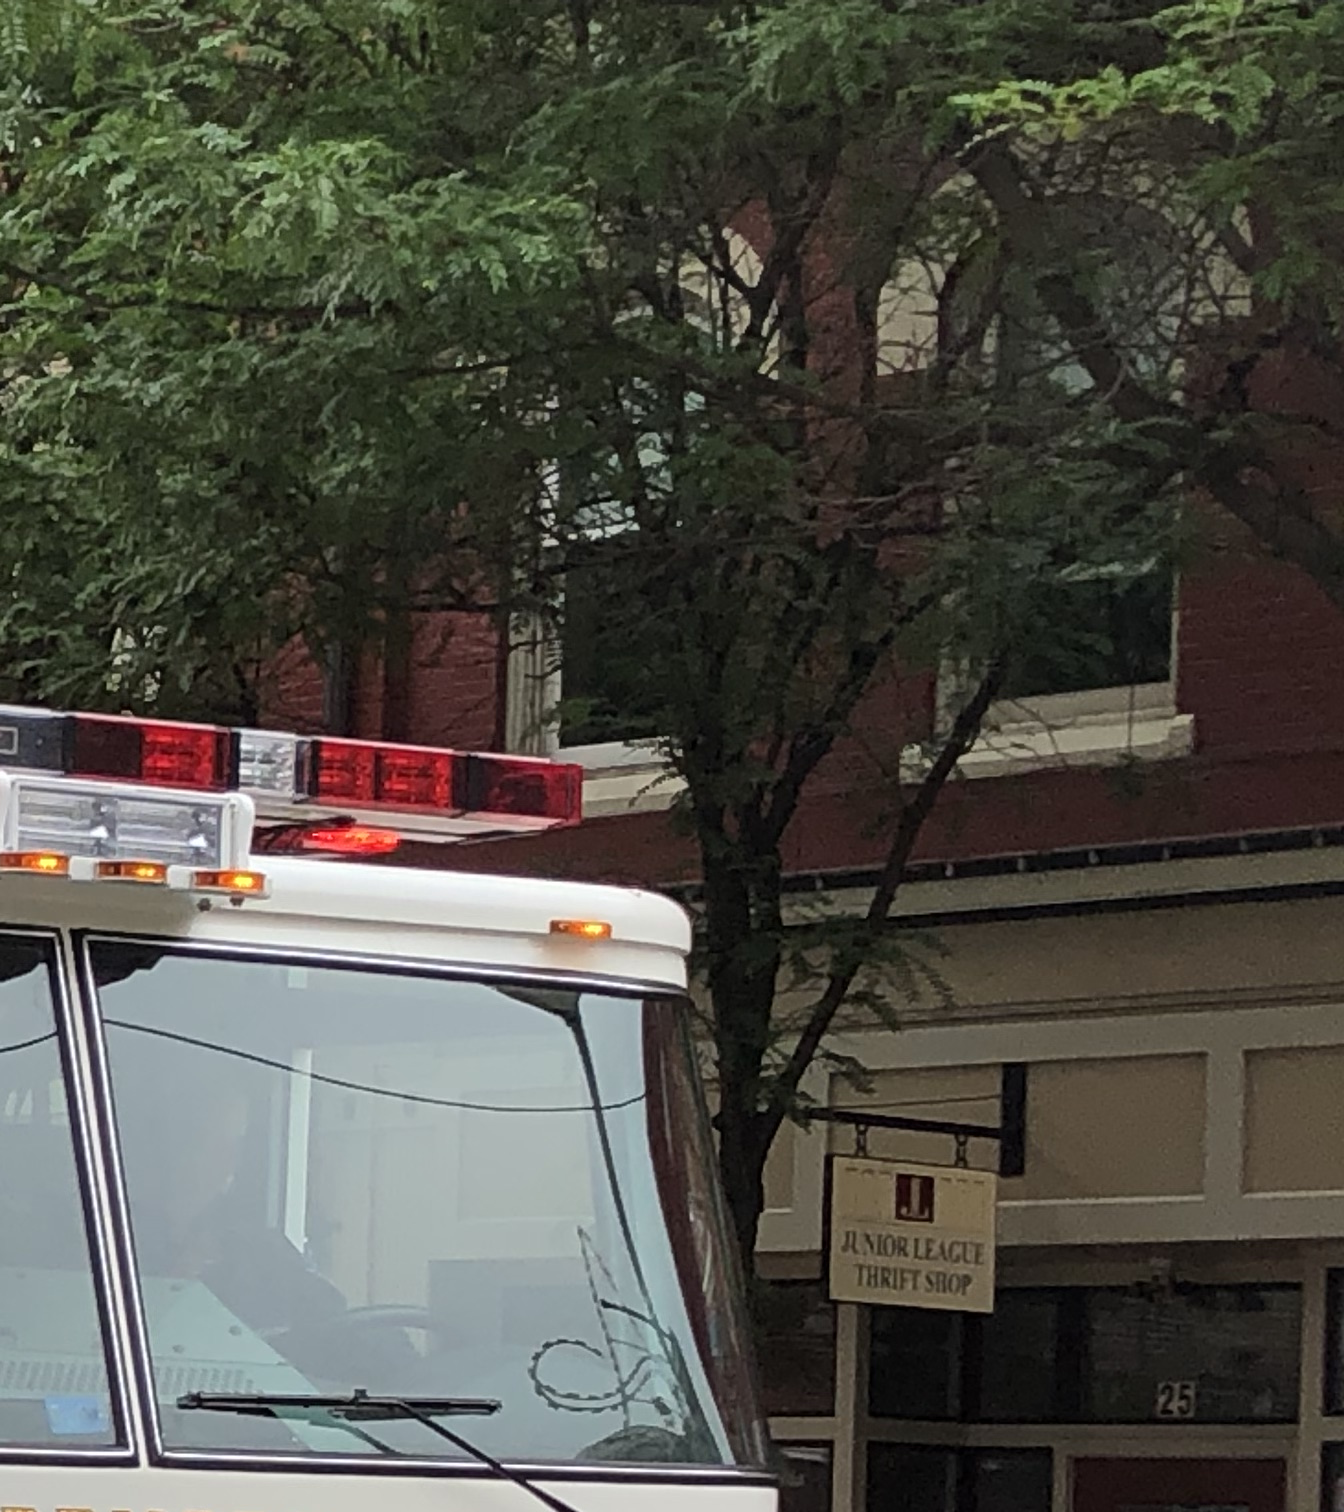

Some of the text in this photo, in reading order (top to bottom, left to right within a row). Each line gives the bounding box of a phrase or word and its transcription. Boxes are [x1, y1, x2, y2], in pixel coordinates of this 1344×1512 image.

[841, 1230, 985, 1265] JUNIOR LEAGUE
[854, 1264, 973, 1296] THRIFT SHOP
[1159, 1384, 1191, 1415] 25
